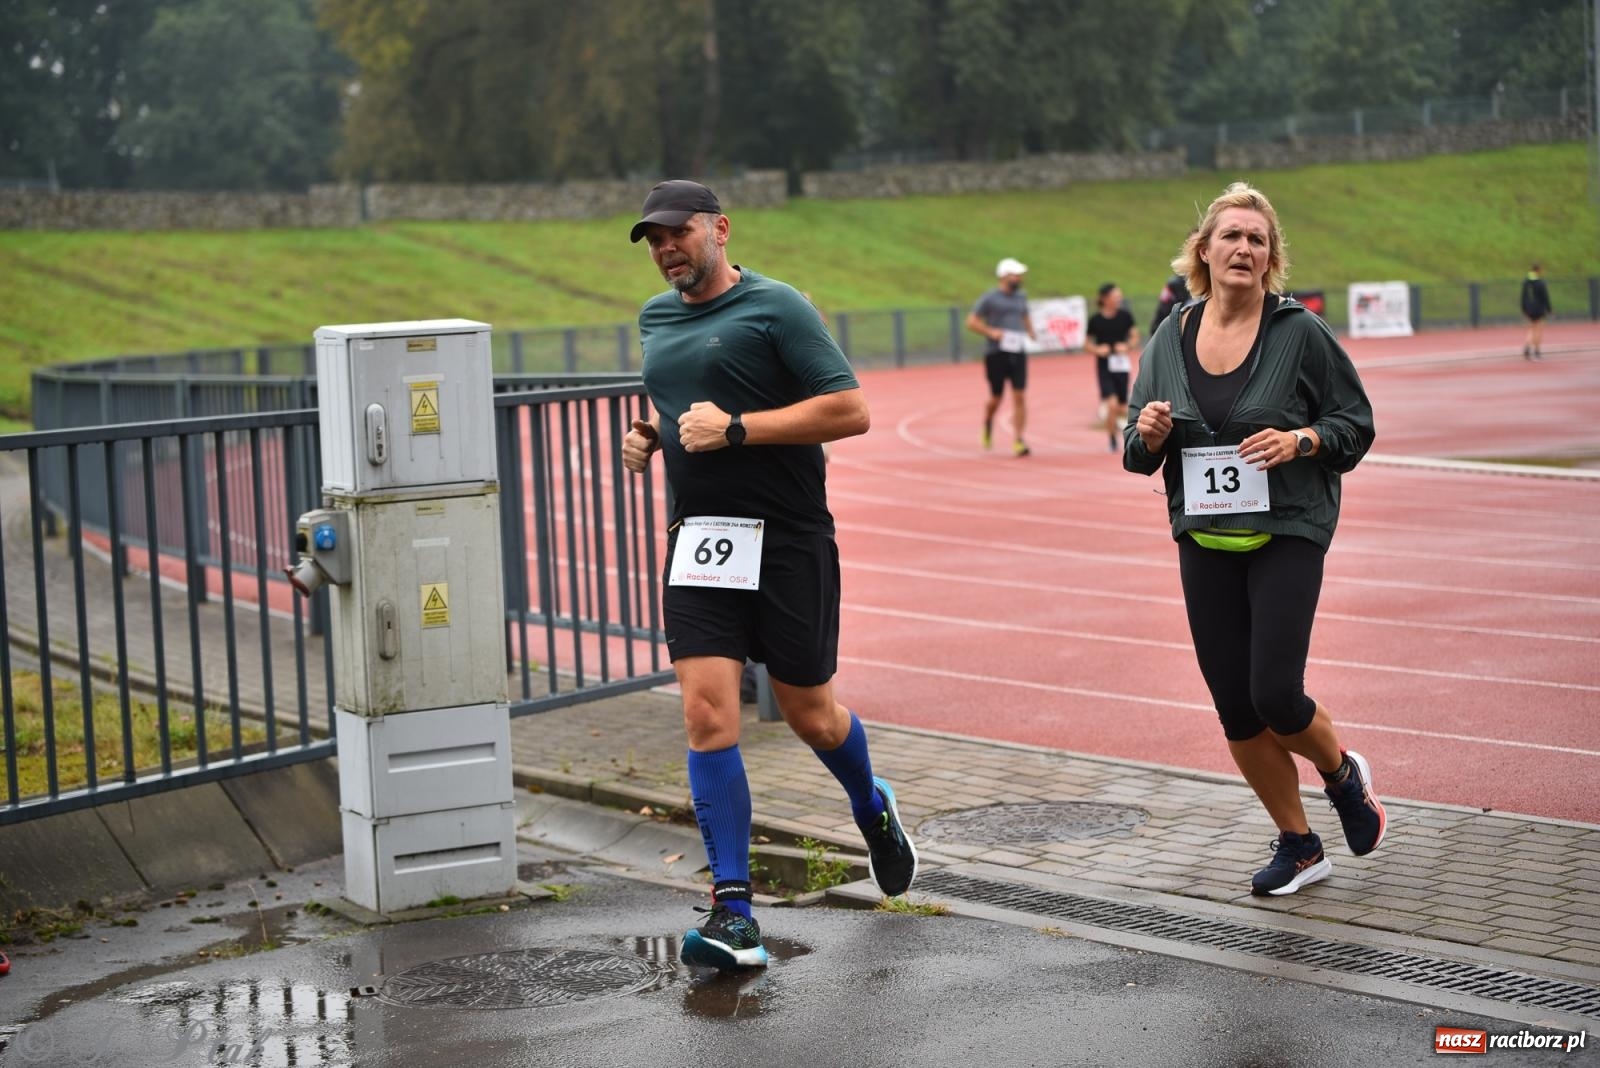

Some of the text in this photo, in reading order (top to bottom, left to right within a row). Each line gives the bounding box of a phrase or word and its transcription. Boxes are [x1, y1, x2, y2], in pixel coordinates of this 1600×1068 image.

[1204, 466, 1241, 494] 13
[1199, 501, 1233, 510] Racibórz
[694, 537, 734, 566] 69
[686, 573, 721, 582] Racibórz
